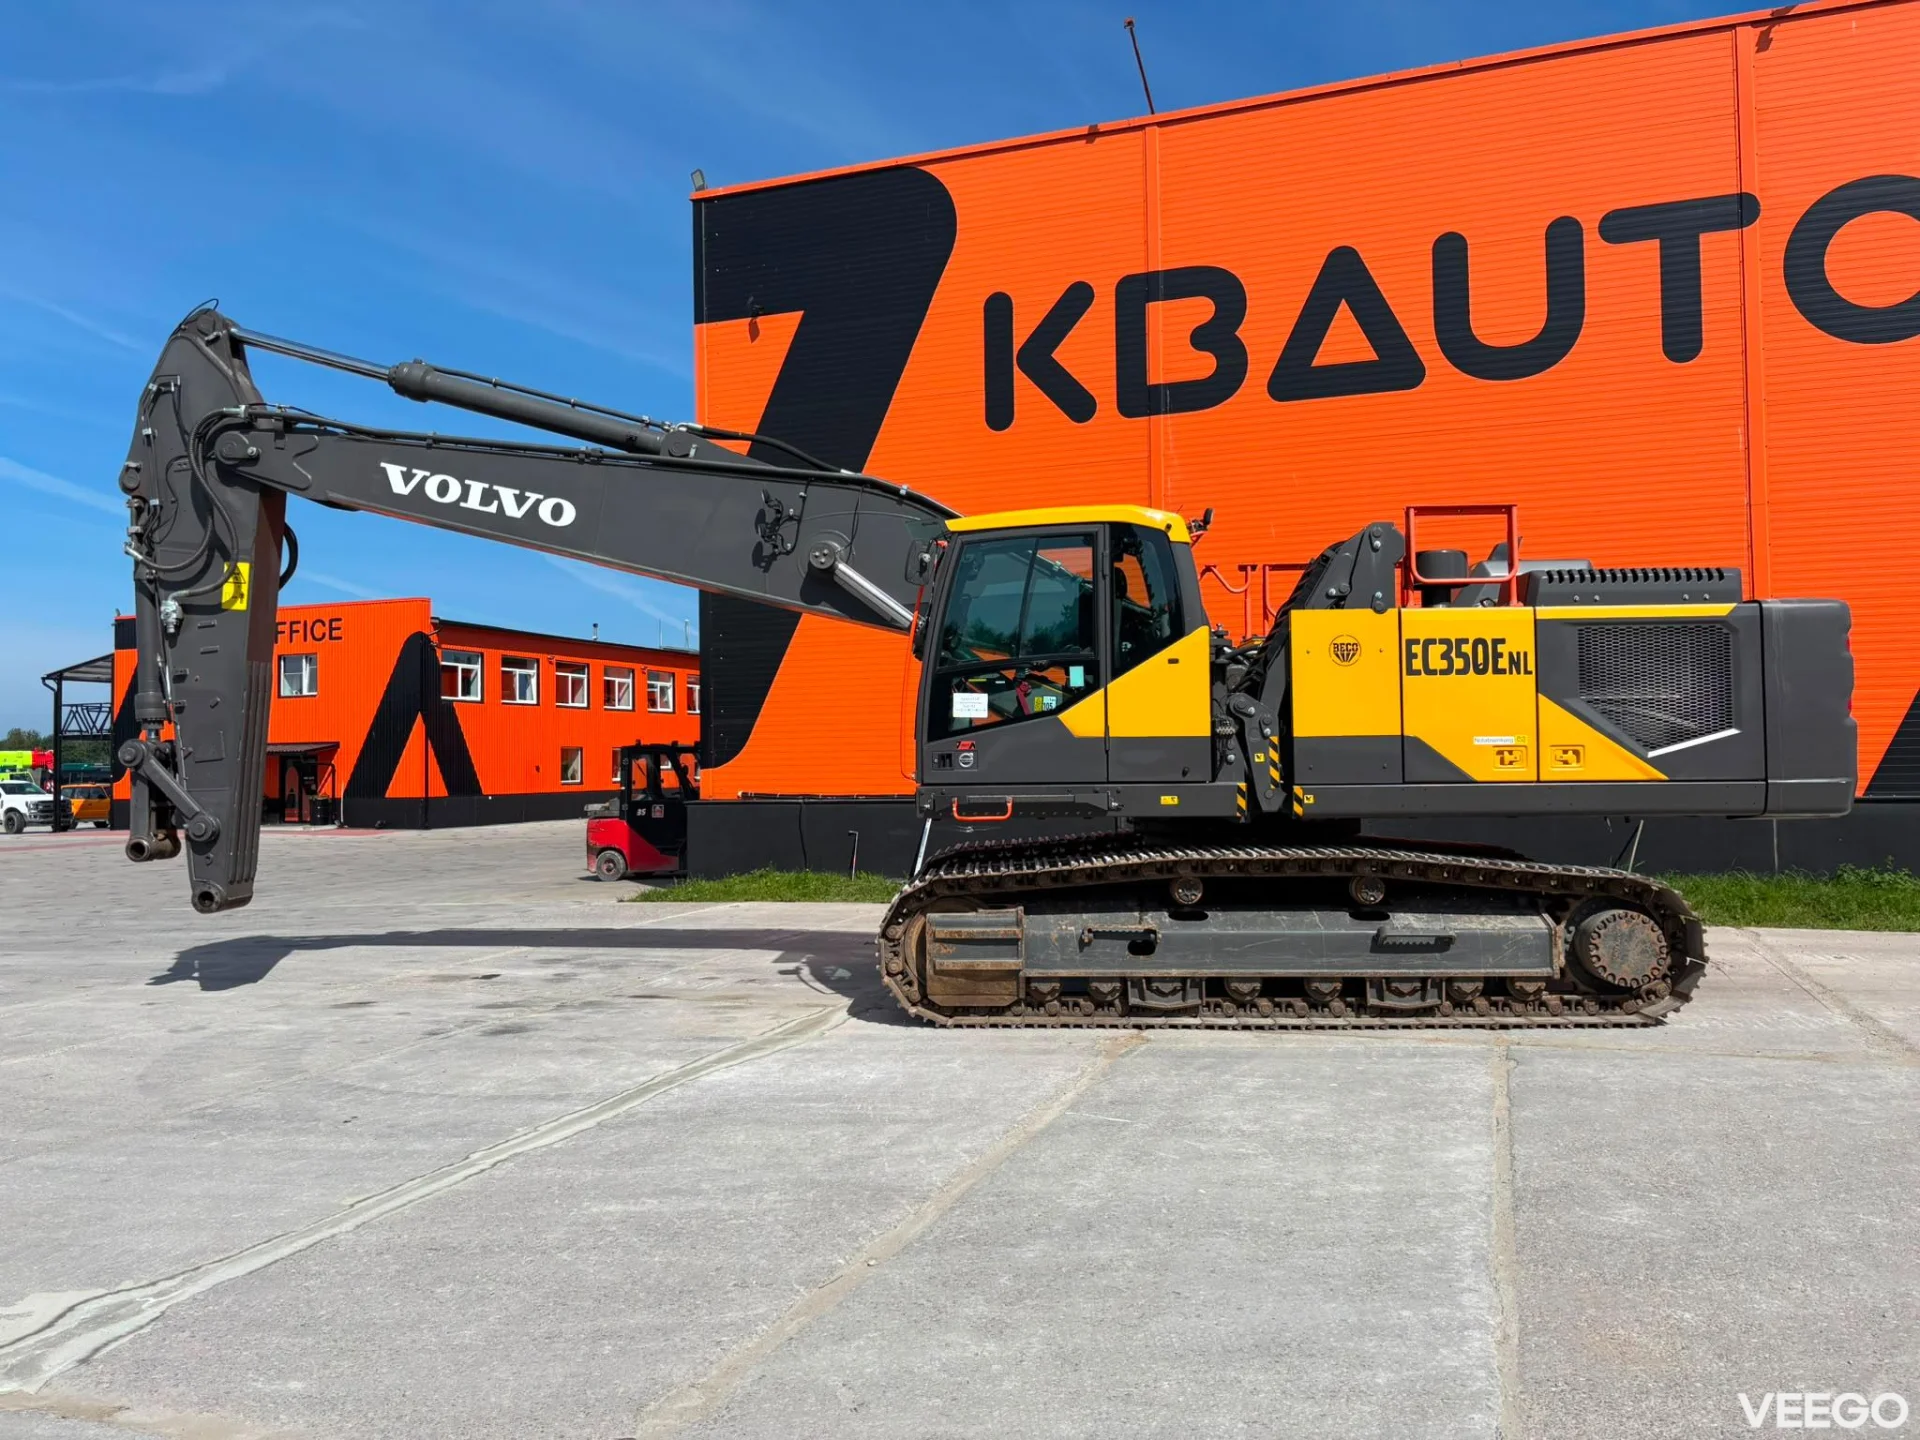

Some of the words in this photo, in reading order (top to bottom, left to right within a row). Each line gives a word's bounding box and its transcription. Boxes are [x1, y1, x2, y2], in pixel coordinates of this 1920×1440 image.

[984, 173, 1920, 432] KBAUTO
[380, 462, 577, 527] VOLVO
[275, 617, 343, 645] FFICE
